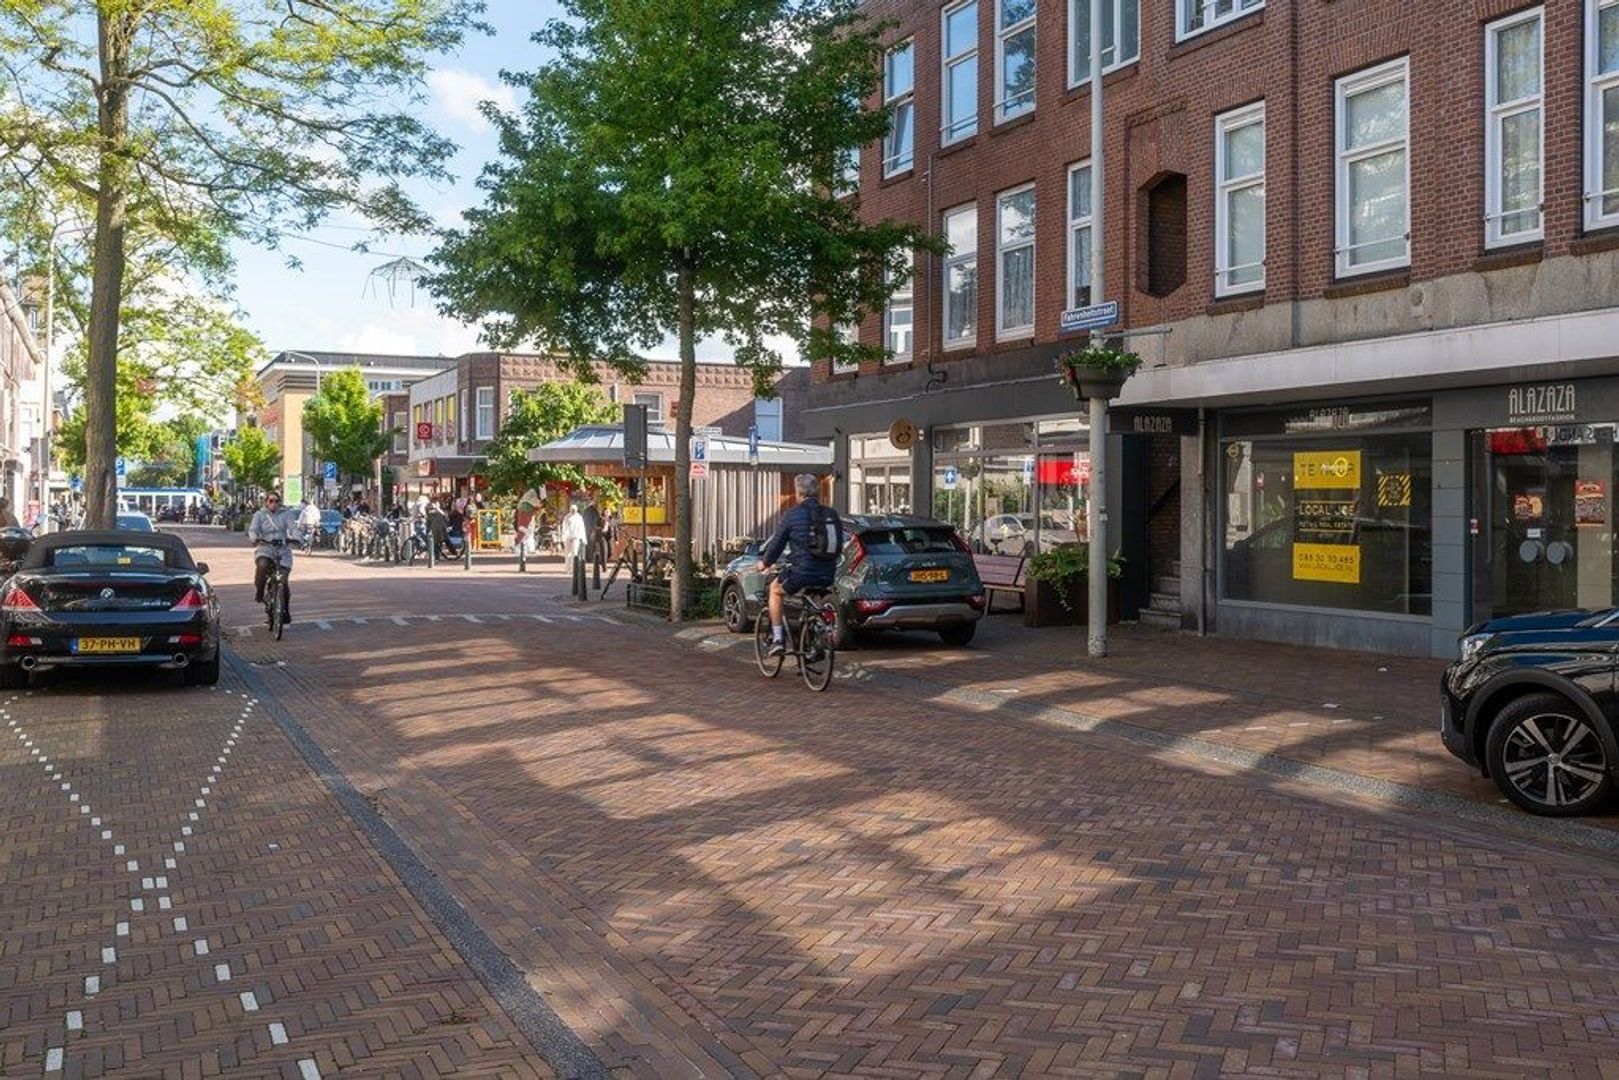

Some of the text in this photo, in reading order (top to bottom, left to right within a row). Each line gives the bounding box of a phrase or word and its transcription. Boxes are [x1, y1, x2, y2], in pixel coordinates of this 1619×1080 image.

[1508, 384, 1575, 414] ALAZAZA
[1134, 415, 1172, 432] ALAZAZA
[1300, 463, 1315, 476] TE
[1300, 505, 1355, 517] LOCAL JOE
